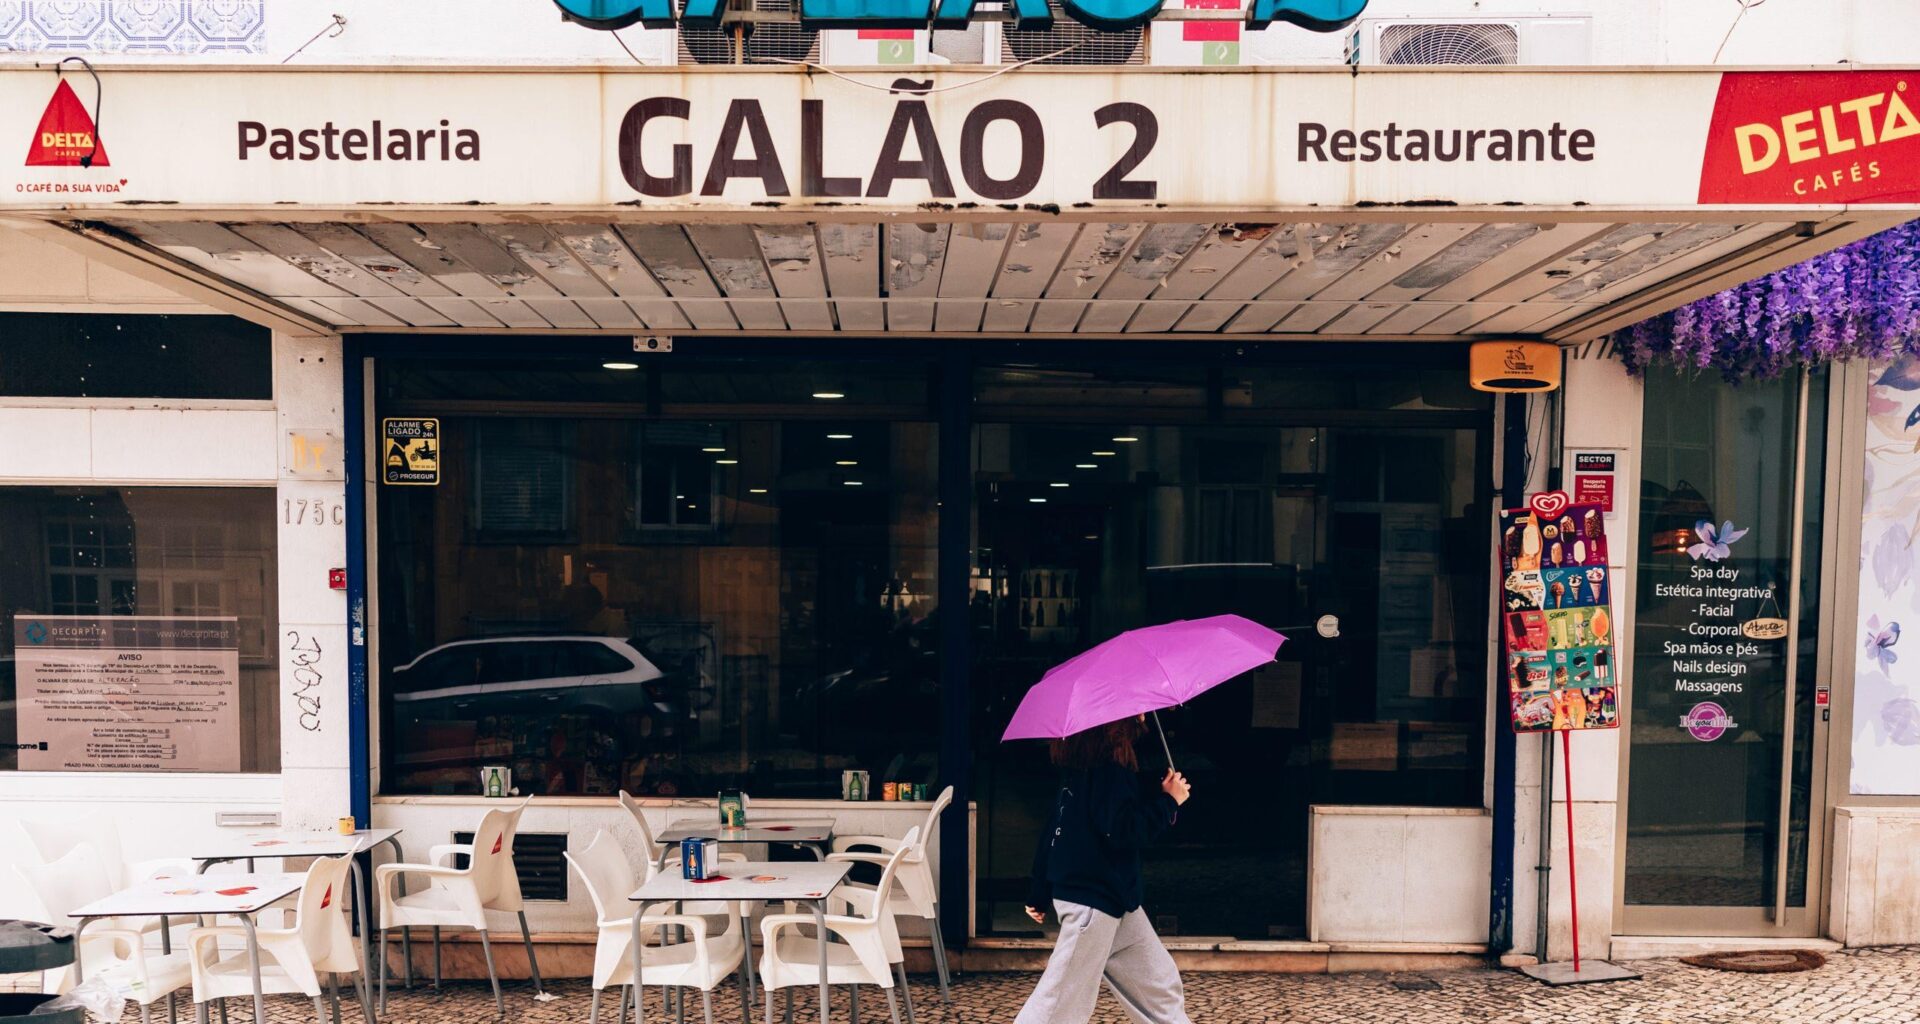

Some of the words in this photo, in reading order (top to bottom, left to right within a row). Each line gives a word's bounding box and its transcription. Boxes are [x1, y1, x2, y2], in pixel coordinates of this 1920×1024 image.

[42, 132, 95, 148] DELTA
[237, 119, 480, 161] Pastelaria
[618, 77, 1046, 200] GALÃO
[1092, 100, 1159, 199] 2
[1297, 121, 1596, 162] Restaurante
[1793, 161, 1881, 195] CAFÉS
[16, 184, 23, 192] O
[26, 182, 52, 192] CAFÉ
[55, 184, 69, 192] DA
[72, 184, 92, 192] SUA
[95, 184, 120, 192] VIDA
[1690, 565, 1713, 581] Spa
[1716, 566, 1740, 581] day
[1655, 583, 1703, 597] Estética
[1705, 585, 1772, 600] integrativa
[1699, 603, 1734, 616] Facial
[1689, 622, 1742, 638] Corporal
[117, 653, 142, 661] AVISO
[1663, 640, 1686, 656] Spa
[1689, 642, 1722, 654] mãos
[1725, 645, 1734, 654] e
[1736, 643, 1758, 658] pés
[1673, 660, 1702, 673] Nails
[1705, 661, 1747, 676] design
[1675, 679, 1743, 695] Massagens
